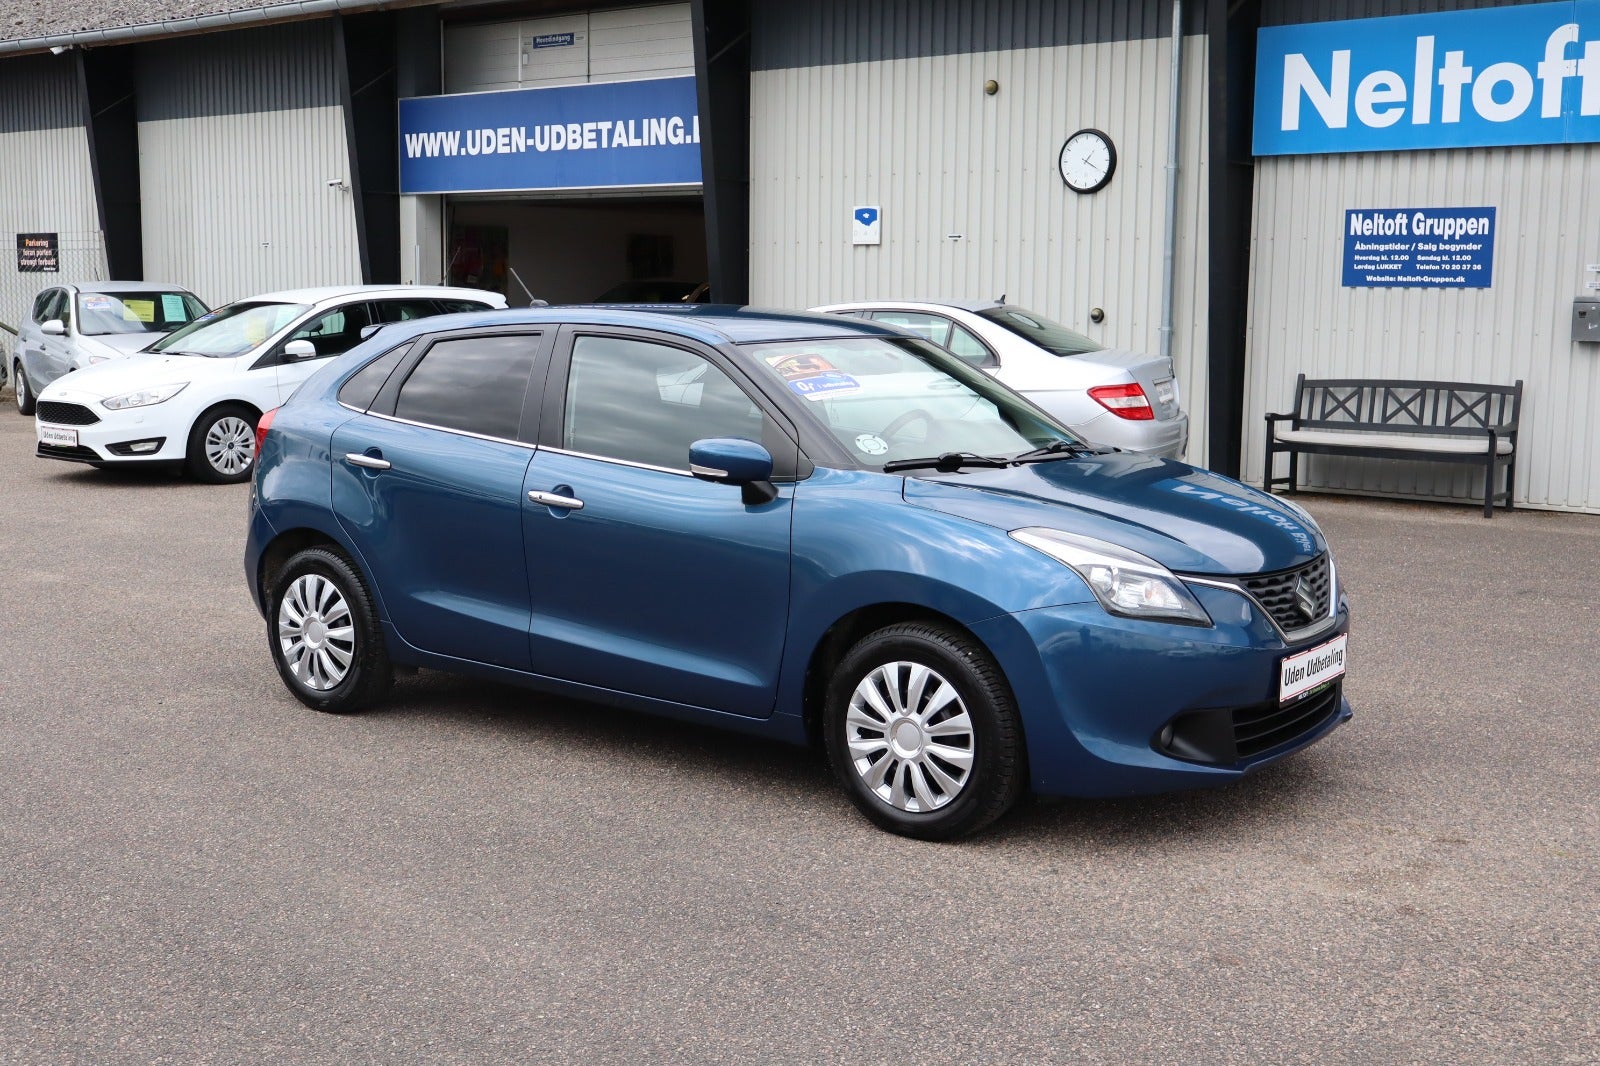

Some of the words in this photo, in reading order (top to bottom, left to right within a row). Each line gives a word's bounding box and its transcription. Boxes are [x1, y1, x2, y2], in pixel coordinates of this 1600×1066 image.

[1350, 213, 1408, 236] Neltoft
[1412, 211, 1490, 240] Gruppen
[1354, 241, 1410, 251] Åbningstider
[1417, 243, 1437, 251] Salg
[1439, 242, 1482, 252] begynder
[1397, 275, 1466, 283] Neltoft-Gruppen.dk
[1284, 665, 1305, 687] Uden
[1306, 648, 1344, 677] Udbetaling
